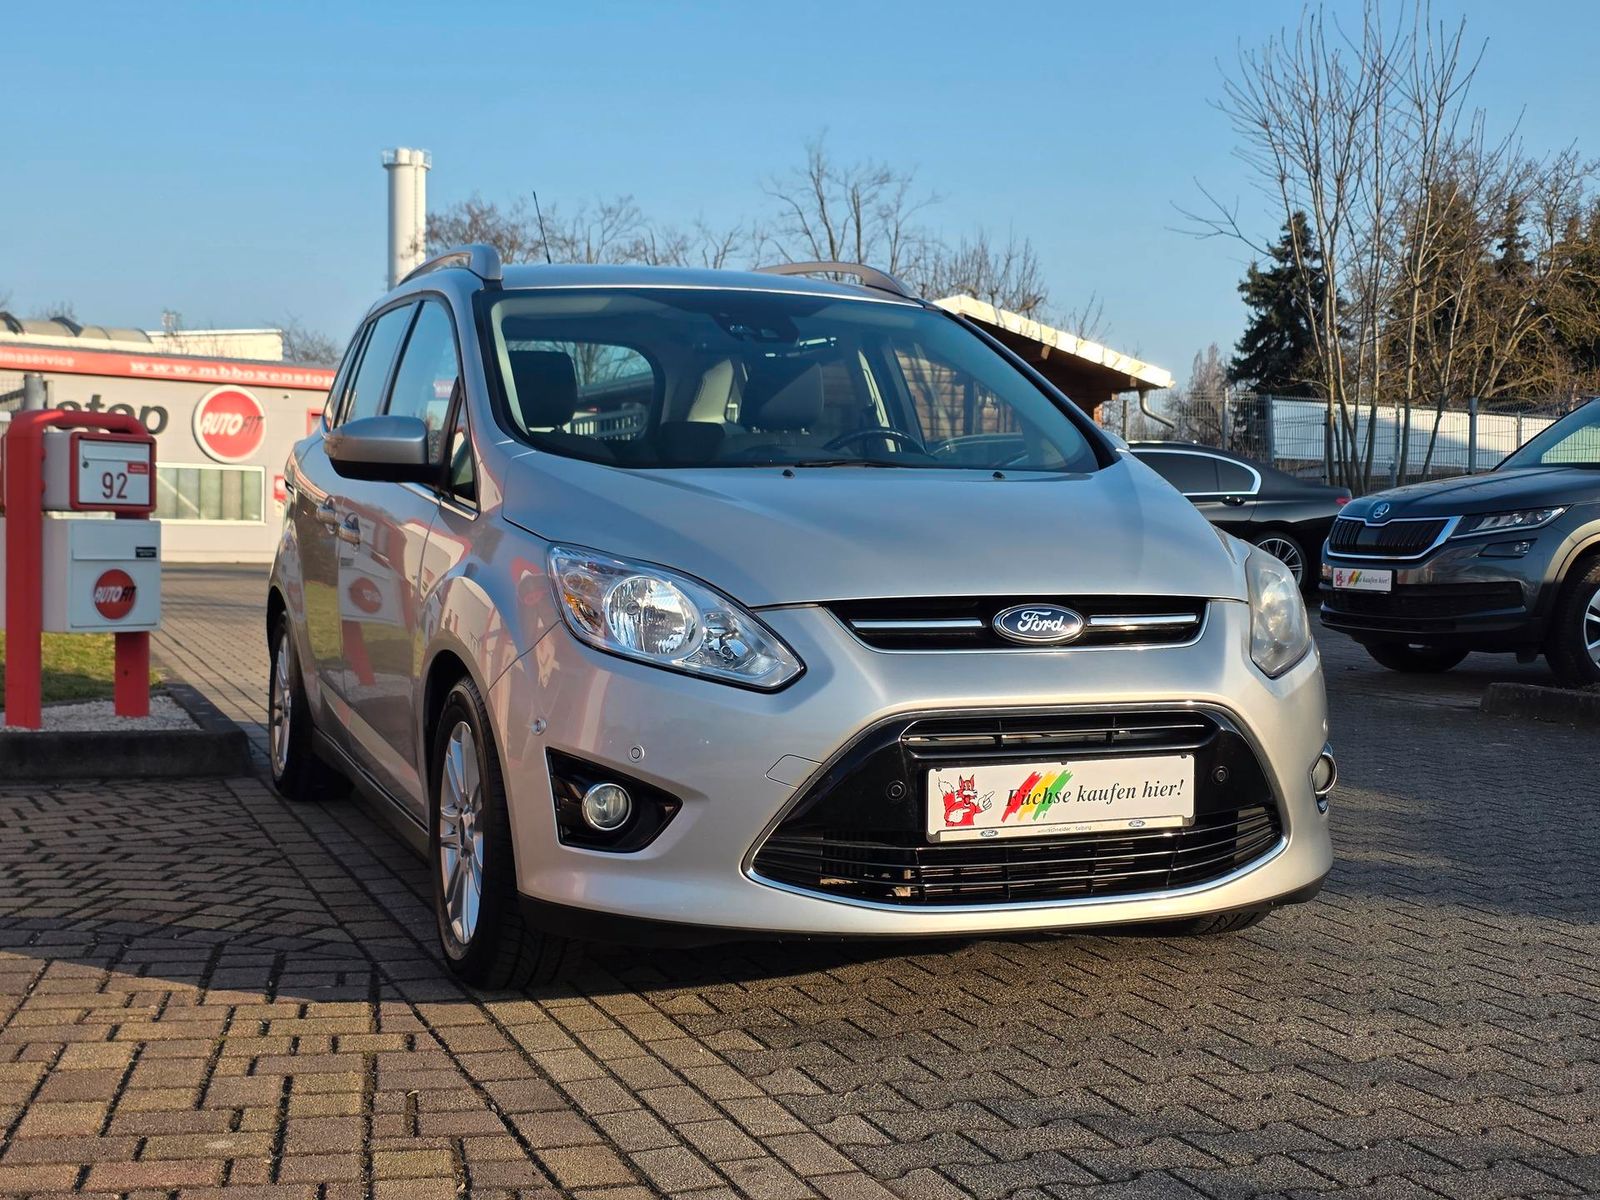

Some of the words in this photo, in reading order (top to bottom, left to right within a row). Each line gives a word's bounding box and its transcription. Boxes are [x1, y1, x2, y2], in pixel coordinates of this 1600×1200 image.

[102, 472, 127, 499] 92
[1017, 610, 1066, 632] Ford
[1007, 787, 1072, 807] Füchse
[1077, 784, 1137, 806] kaufen
[1142, 779, 1185, 798] hier!
